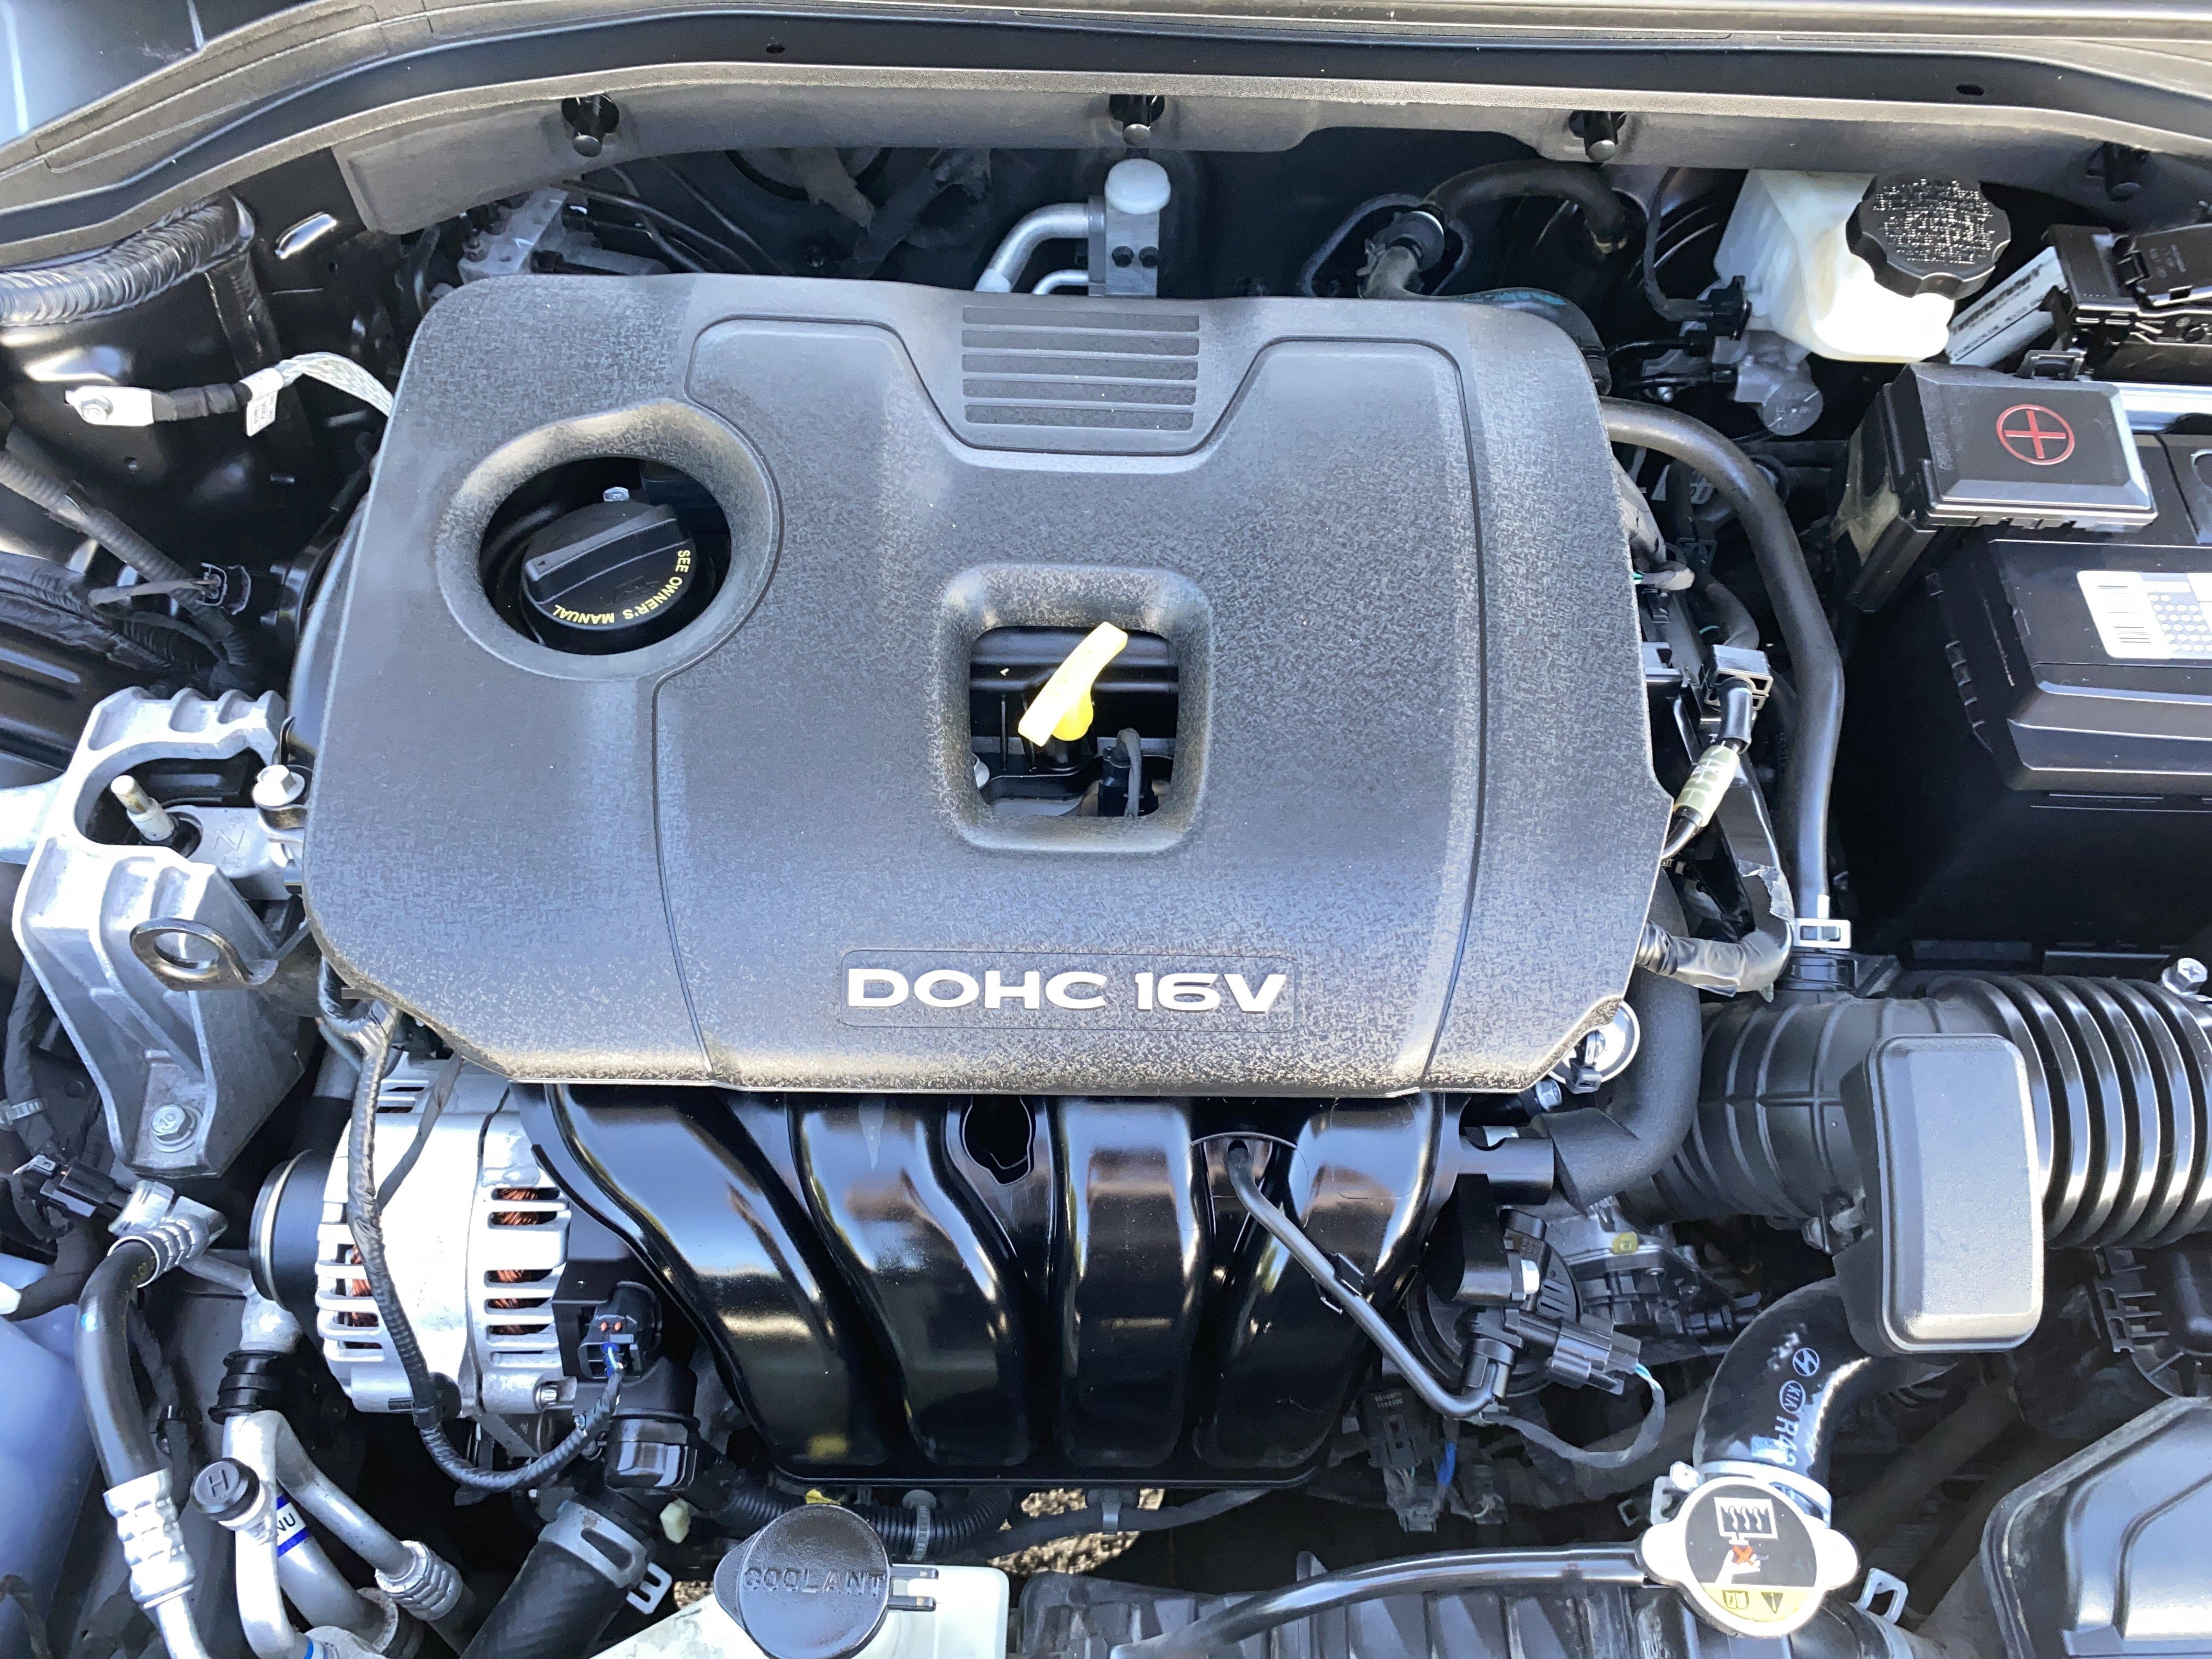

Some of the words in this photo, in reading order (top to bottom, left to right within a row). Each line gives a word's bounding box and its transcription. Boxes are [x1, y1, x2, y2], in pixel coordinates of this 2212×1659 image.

[675, 550, 691, 573] SEE
[622, 577, 683, 619] OWNER'S
[552, 605, 615, 624] MANUAL
[848, 968, 1107, 1011] DOHC
[1135, 972, 1286, 1013] 16V
[206, 1469, 229, 1498] H
[743, 1566, 887, 1596] COOLANT
